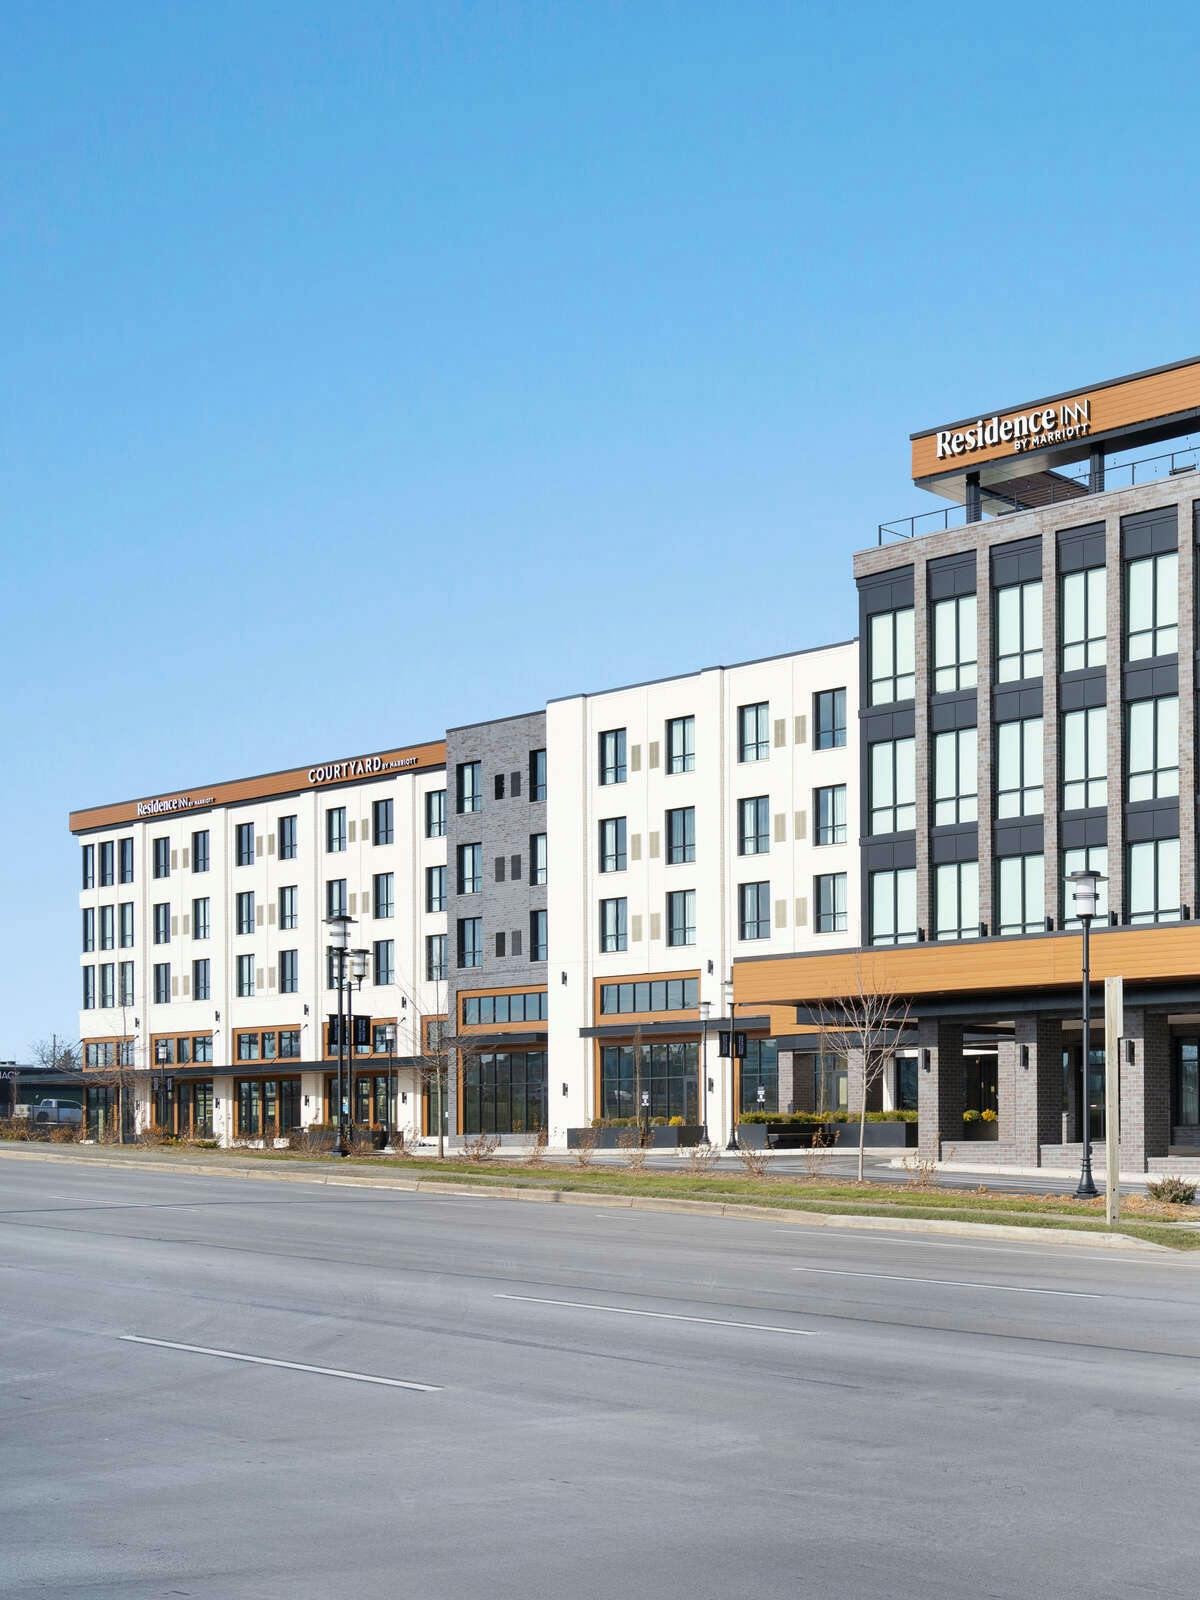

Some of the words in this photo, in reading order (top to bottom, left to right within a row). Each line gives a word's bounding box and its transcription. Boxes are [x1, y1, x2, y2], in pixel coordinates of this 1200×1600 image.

[936, 407, 1056, 458] Residence
[1060, 400, 1090, 425] INN
[1014, 438, 1028, 450] BY
[1031, 424, 1089, 446] MARRIOTT
[308, 757, 381, 783] COURTYARD
[137, 799, 177, 816] Residence
[0, 1071, 20, 1080] ACY
